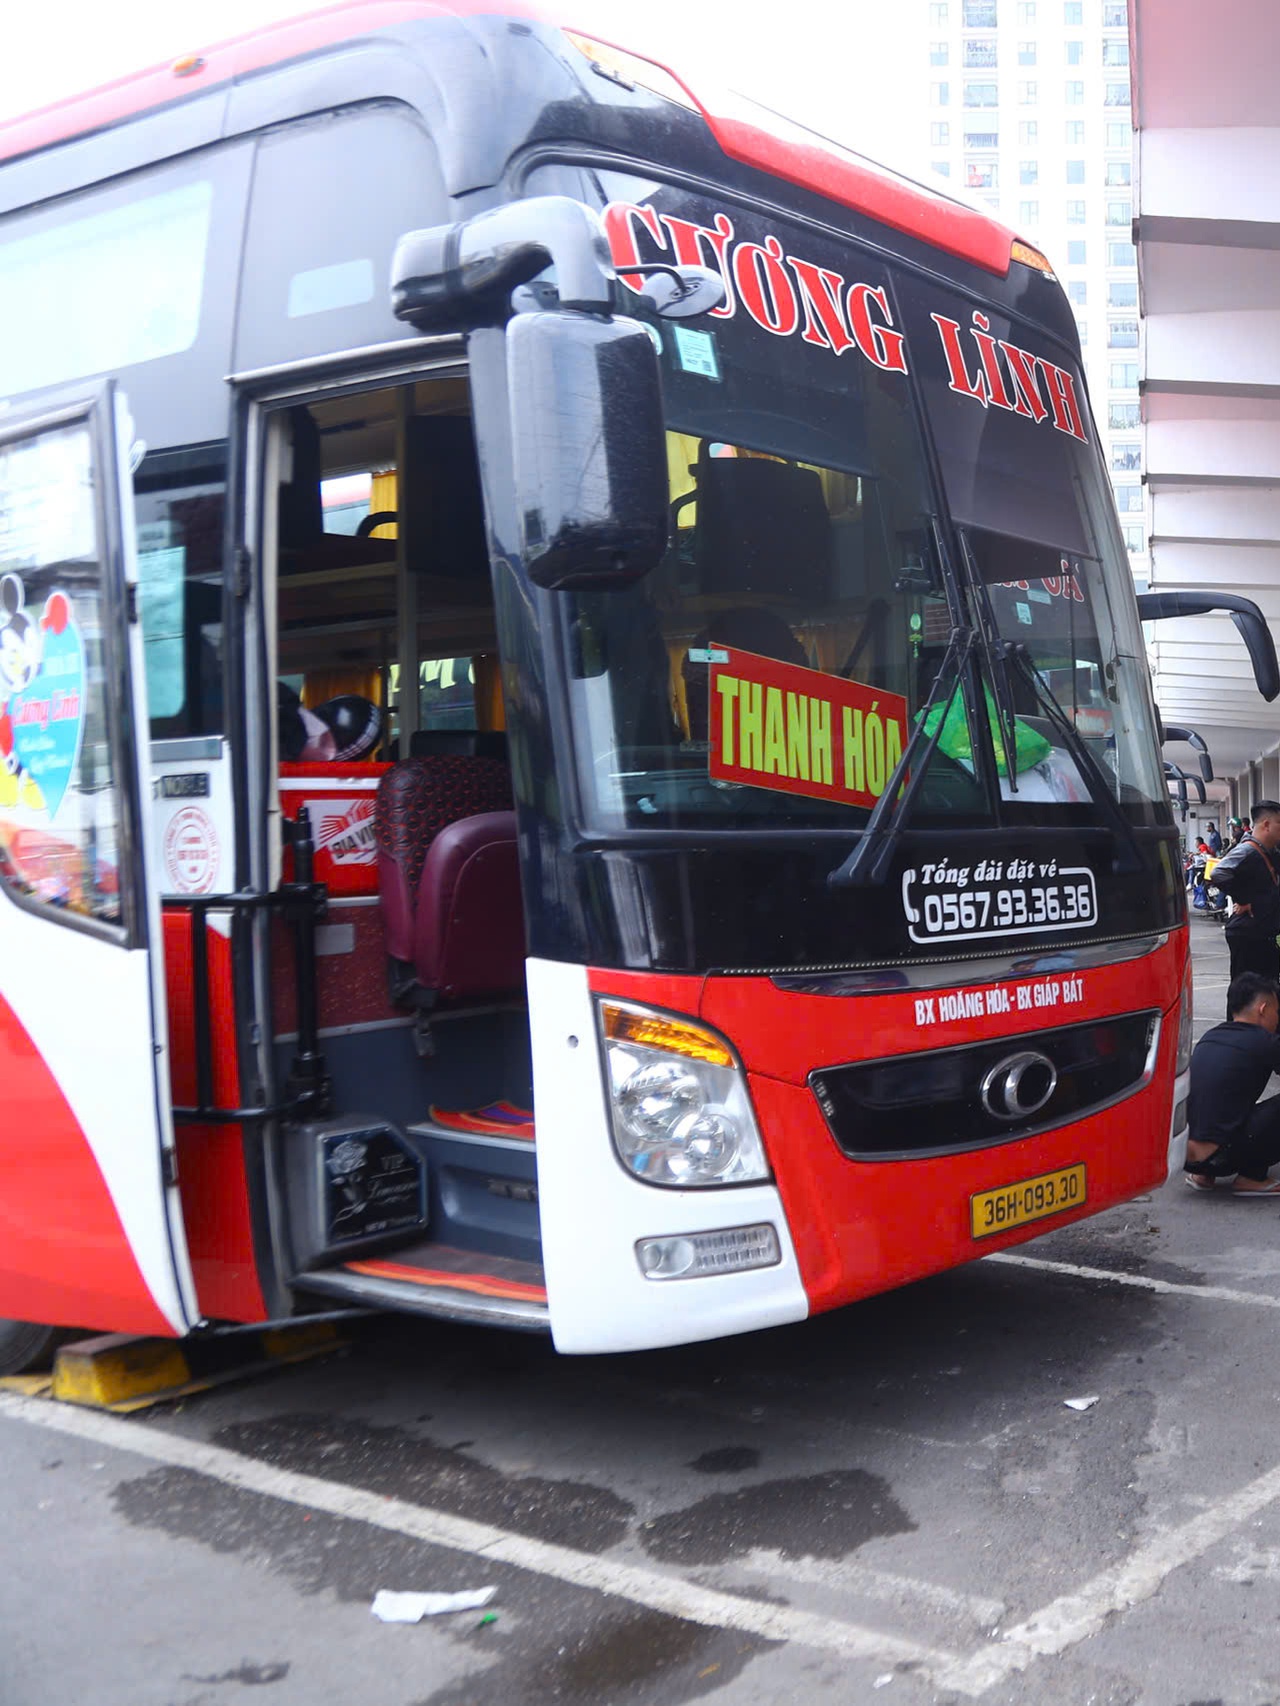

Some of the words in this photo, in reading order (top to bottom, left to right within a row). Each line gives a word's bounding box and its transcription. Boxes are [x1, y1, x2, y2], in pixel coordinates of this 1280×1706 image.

[930, 310, 1089, 444] LĨNH
[716, 673, 833, 786] THANH
[921, 857, 970, 887] Tổng
[974, 859, 1003, 883] đài
[1006, 858, 1035, 883] đặt
[1039, 858, 1057, 878] vé
[924, 884, 1091, 933] 0567.93.36.36
[914, 998, 936, 1026] BX
[985, 983, 1010, 1015] HÓA
[1016, 986, 1033, 1010] BX
[1033, 976, 1060, 1007] GIÁP
[1062, 972, 1083, 1004] BÁT
[984, 1173, 1078, 1227] 36H-093.30
